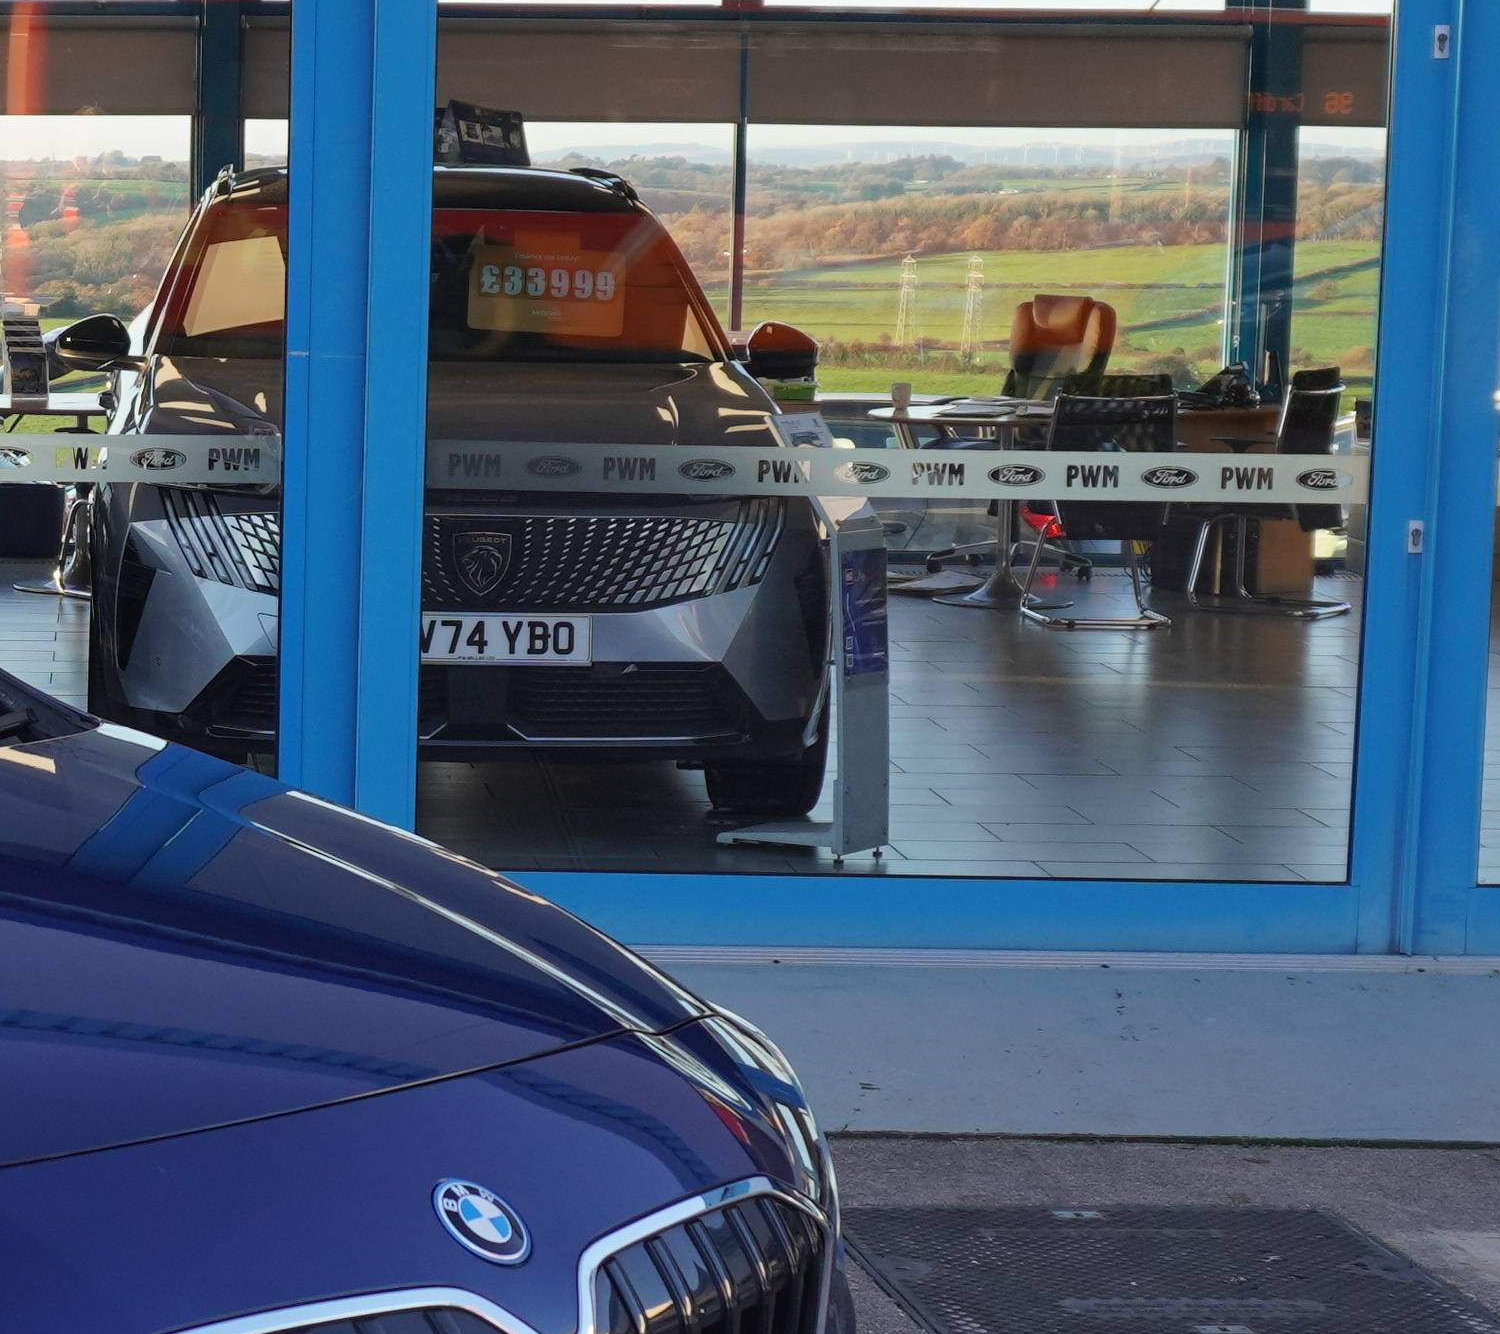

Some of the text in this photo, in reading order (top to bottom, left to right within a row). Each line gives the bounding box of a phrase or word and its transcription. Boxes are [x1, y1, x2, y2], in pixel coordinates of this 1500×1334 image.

[480, 264, 616, 301] £33999
[208, 448, 261, 471] PWM
[448, 453, 502, 477] PWM
[532, 458, 575, 476] Ford
[603, 457, 656, 481] PWM
[686, 461, 730, 480] Ford
[911, 462, 965, 486] PWM
[995, 465, 1037, 485] Ford
[1066, 464, 1119, 488] PWM
[1149, 468, 1190, 487] Ford
[1221, 466, 1274, 490] PWM
[501, 620, 575, 655] YBO
[442, 1184, 495, 1213] BMW
